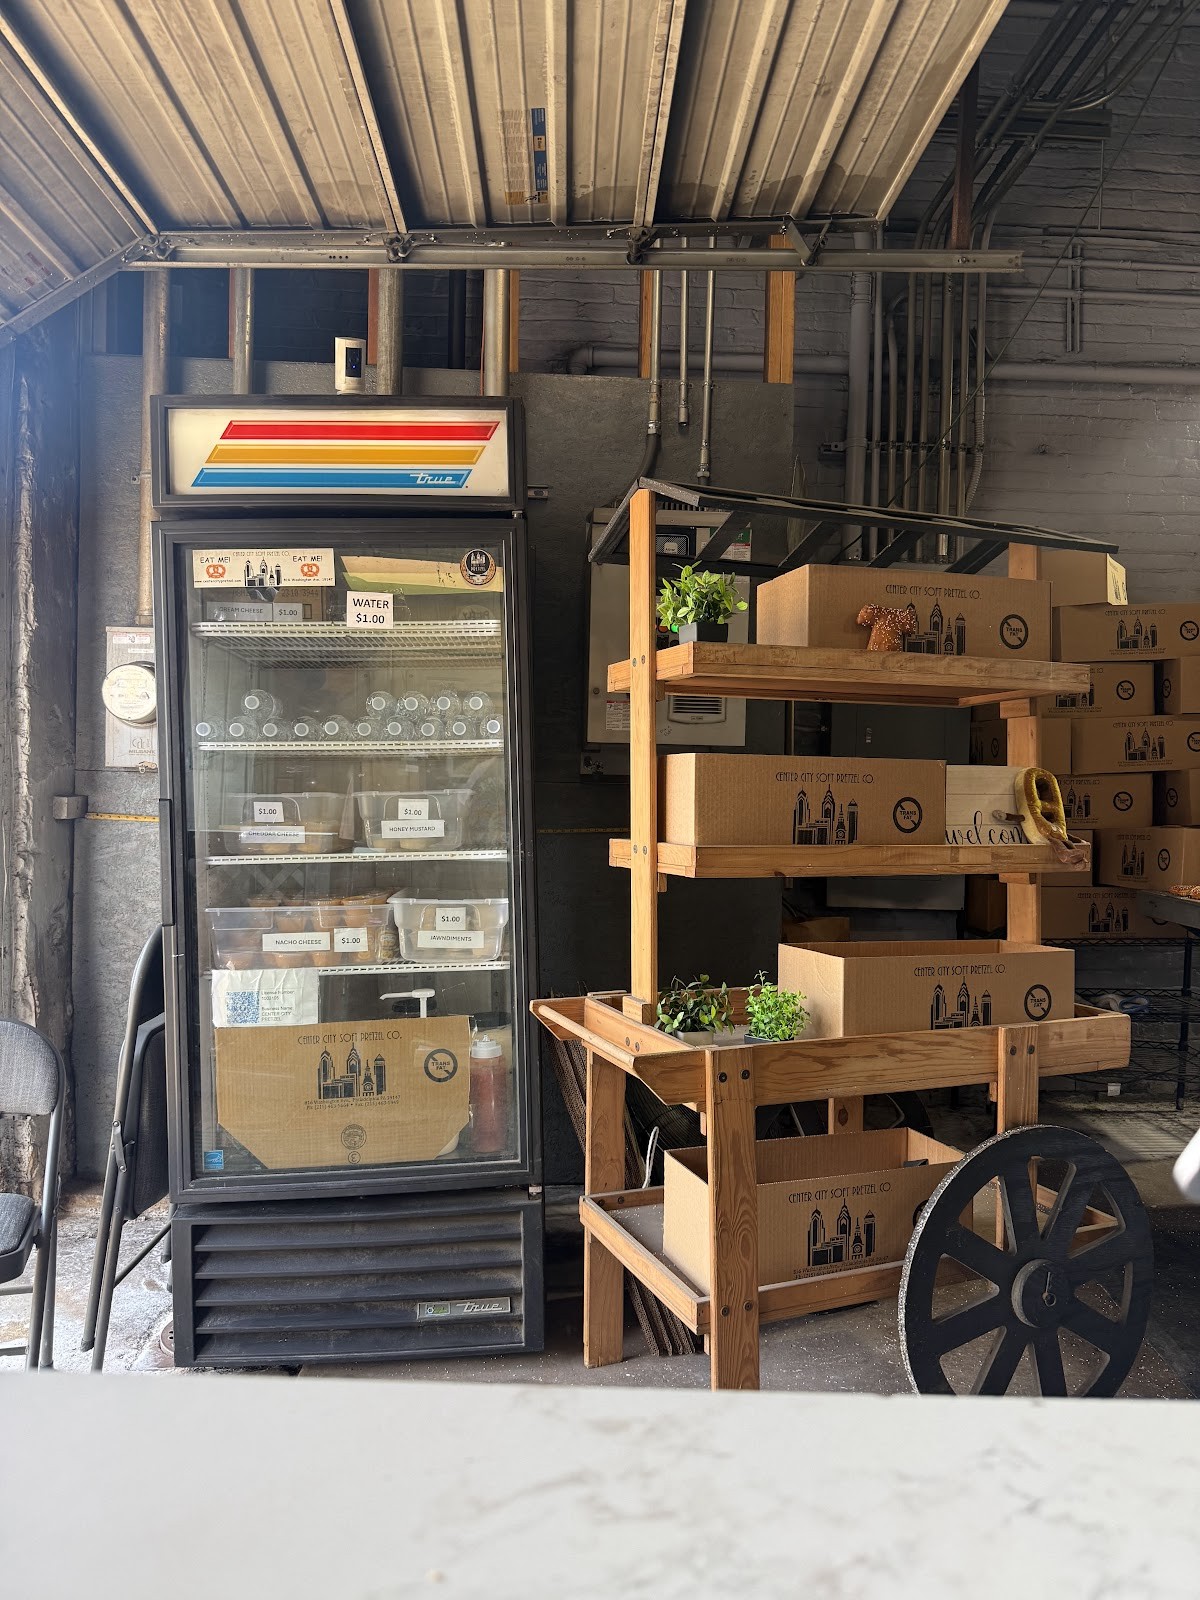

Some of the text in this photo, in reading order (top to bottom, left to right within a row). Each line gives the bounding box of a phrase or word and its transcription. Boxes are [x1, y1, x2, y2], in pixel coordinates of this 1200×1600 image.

[410, 473, 458, 484] true
[293, 555, 306, 563] EAT
[885, 584, 982, 600] CENTER CITY SOFT PRETZEL CO.
[353, 598, 390, 609] WATER
[278, 609, 298, 617] $1.00
[356, 613, 385, 624] $1.00
[775, 771, 875, 784] CENTER CITY SOFT PRETZEL CO.
[258, 808, 277, 816] $1.00
[404, 808, 422, 816] $1.00
[441, 915, 461, 923] $1.00
[341, 937, 361, 945] $1.00
[914, 963, 1008, 977] CENTER CITY SOFT PRETZEL CO.
[297, 1030, 403, 1046] CENTER CITY SOFT PRETZEL CO.
[788, 1182, 893, 1204] CENTER CITY SOFT PRETZEL CO.
[456, 1302, 504, 1312] true
